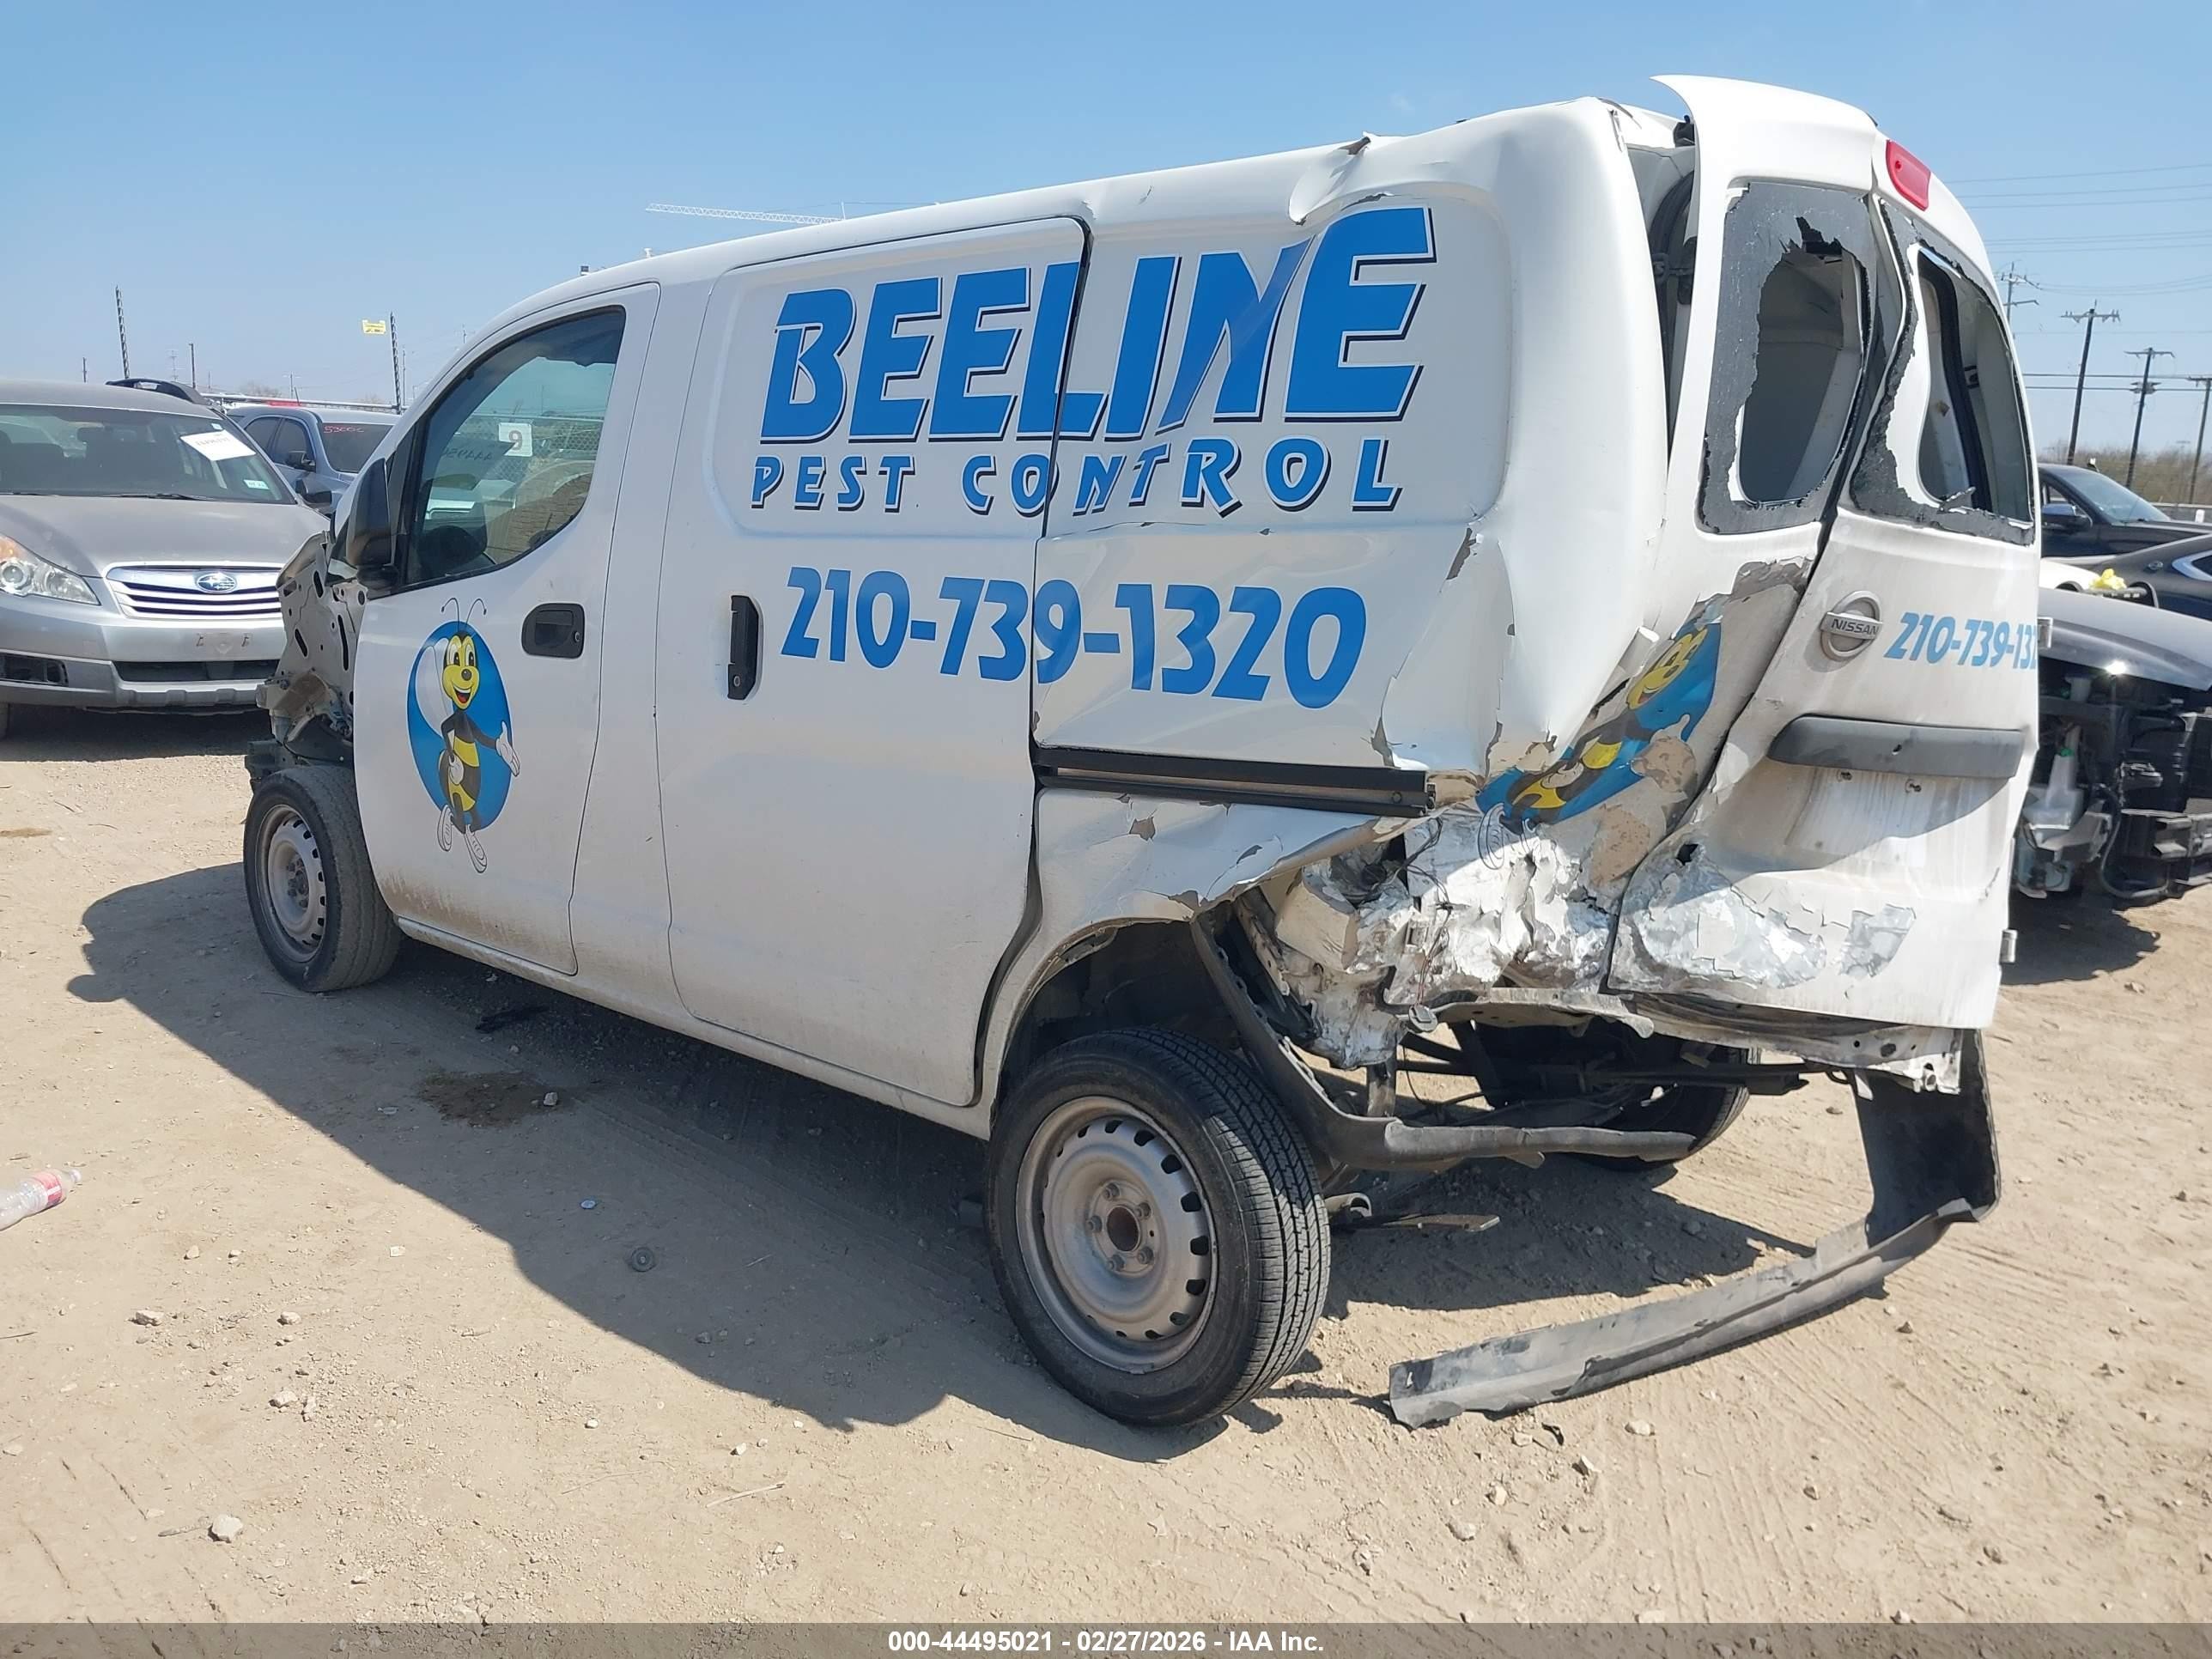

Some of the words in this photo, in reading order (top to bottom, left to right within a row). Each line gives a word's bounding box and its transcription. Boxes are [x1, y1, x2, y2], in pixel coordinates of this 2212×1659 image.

[759, 206, 1437, 443] BEELINE
[750, 453, 915, 514] PEST
[962, 435, 1403, 518] CONTROL
[781, 566, 1367, 710] 210-739-1320
[1831, 618, 1880, 635] NISSAN
